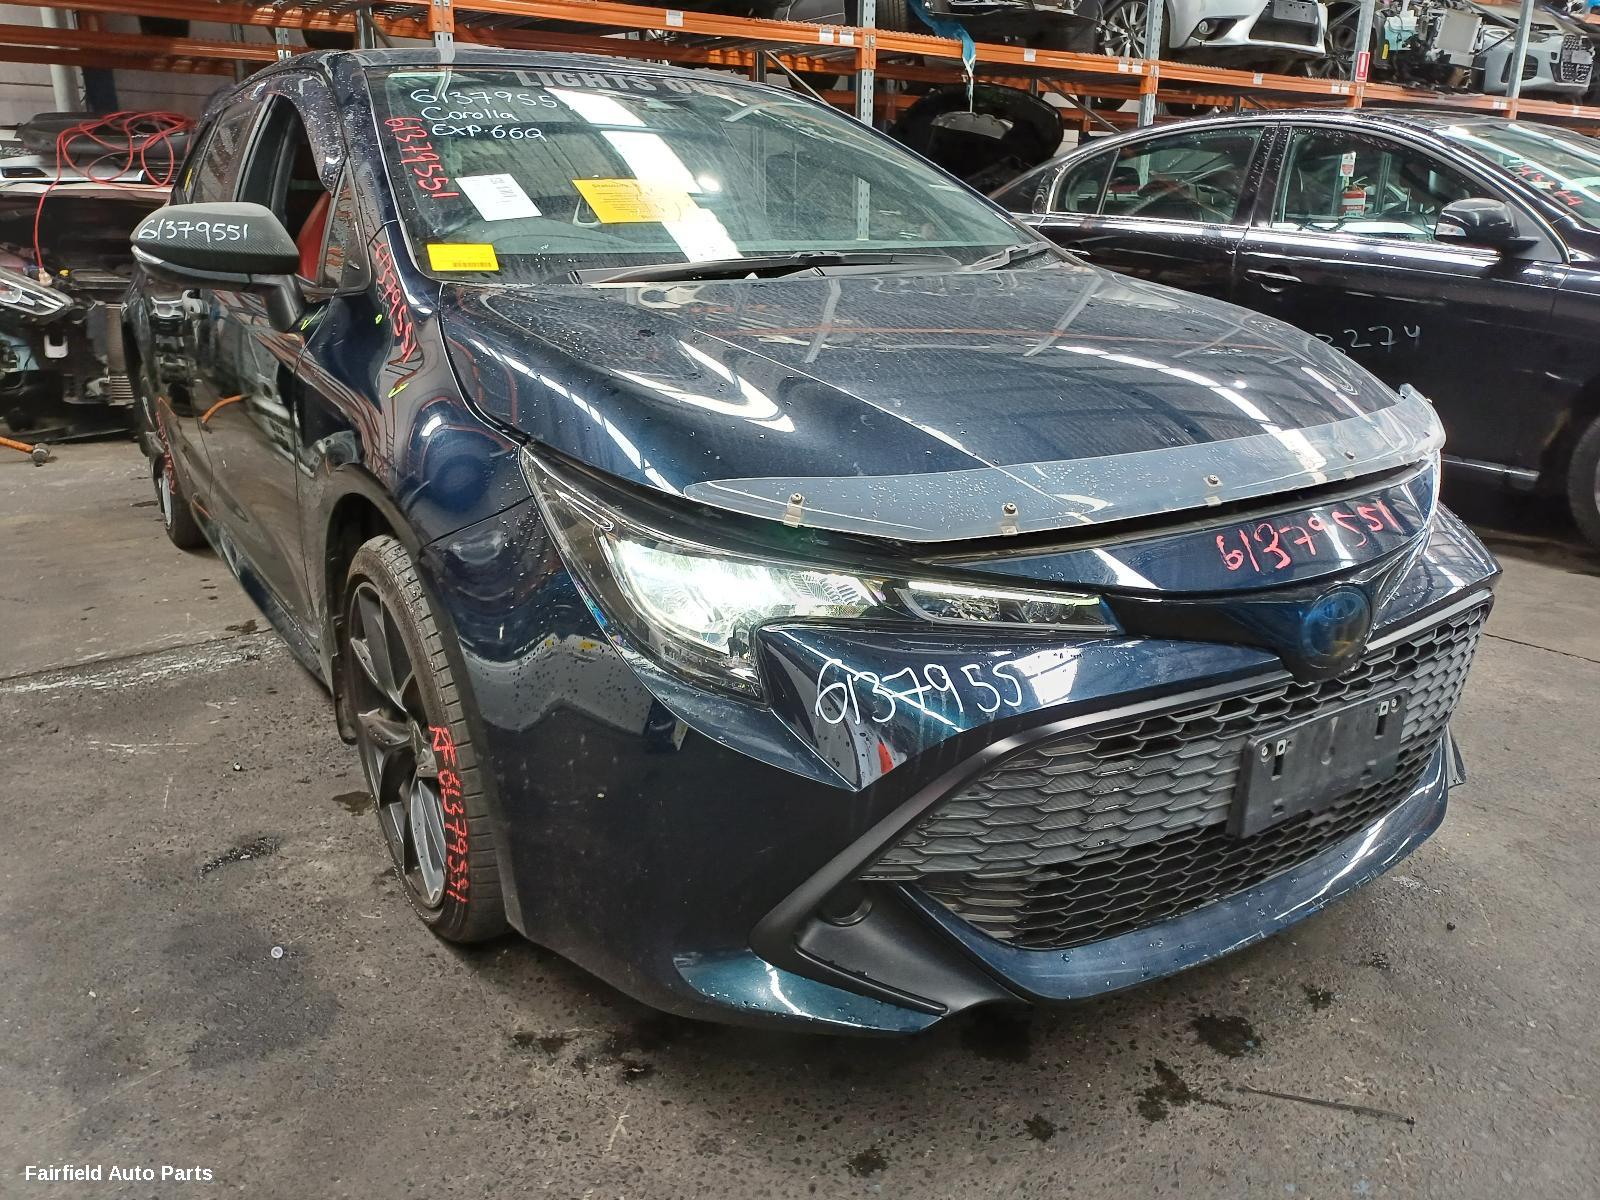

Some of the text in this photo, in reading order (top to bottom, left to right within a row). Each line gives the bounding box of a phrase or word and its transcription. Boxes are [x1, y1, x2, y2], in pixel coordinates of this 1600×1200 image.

[514, 71, 657, 91] LIGHTS
[421, 106, 520, 121] Corolla
[384, 117, 460, 198] 61379551
[138, 219, 248, 243] 61379551
[1216, 500, 1404, 572] 61379551
[815, 659, 1023, 724] 6137955
